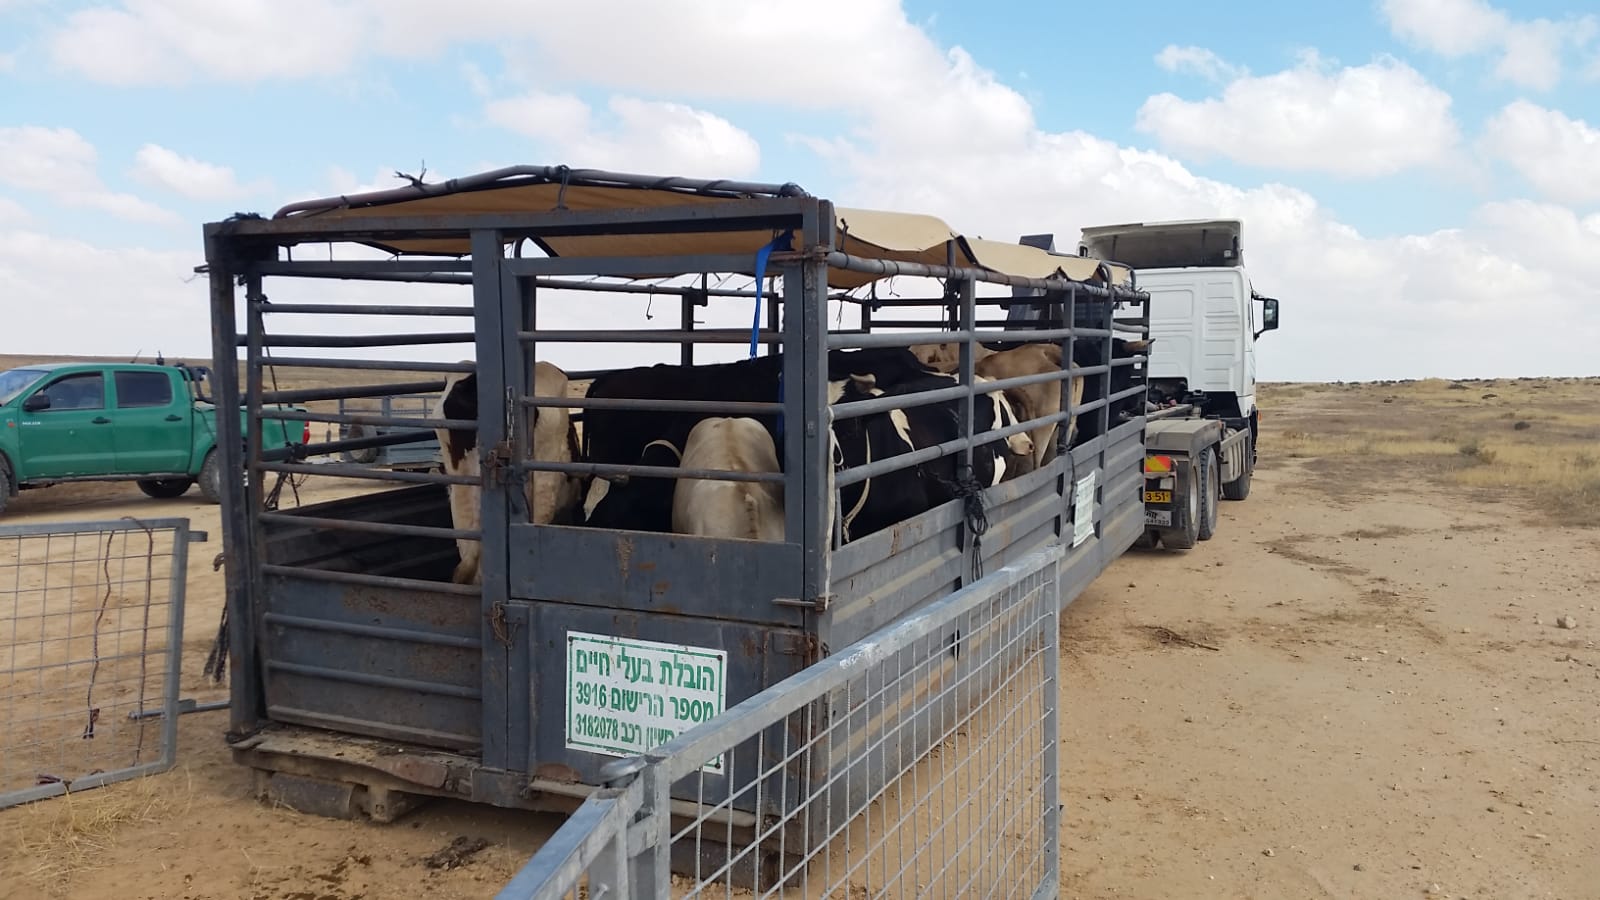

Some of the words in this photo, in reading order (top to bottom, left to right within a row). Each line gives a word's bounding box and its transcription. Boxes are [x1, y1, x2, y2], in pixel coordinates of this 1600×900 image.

[575, 649, 611, 677] חיים
[616, 647, 654, 683] בעלי
[659, 654, 715, 692] הובלת
[575, 681, 607, 708] 3916
[611, 688, 664, 717] הרישום
[669, 696, 714, 723] מספר
[575, 713, 619, 741] 3182078
[621, 719, 642, 746] רכב
